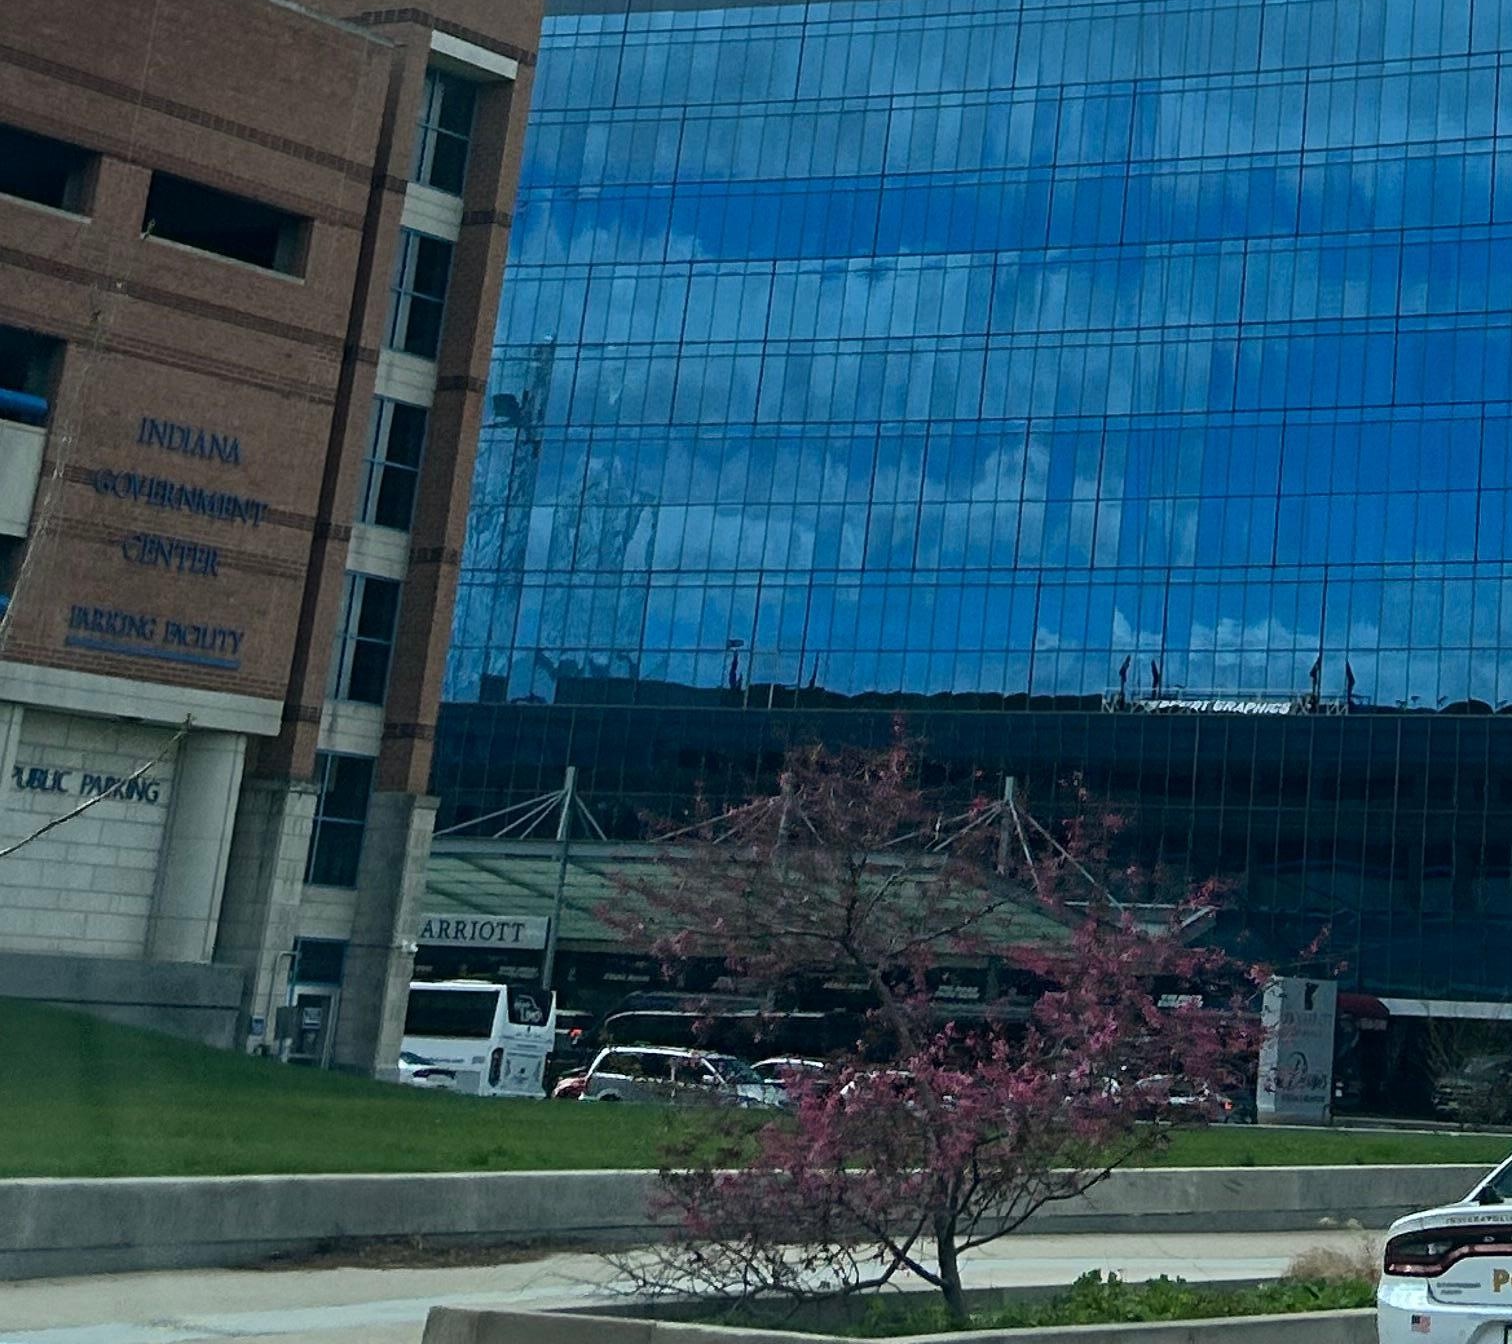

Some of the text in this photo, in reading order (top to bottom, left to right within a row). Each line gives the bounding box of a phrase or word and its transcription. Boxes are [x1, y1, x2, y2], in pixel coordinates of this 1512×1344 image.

[137, 416, 241, 465] INDIANA
[94, 468, 269, 526] GOVERNMENT
[120, 530, 221, 577] CENTER
[70, 605, 243, 654] PARKING FACILITY
[80, 774, 161, 804] PARKING
